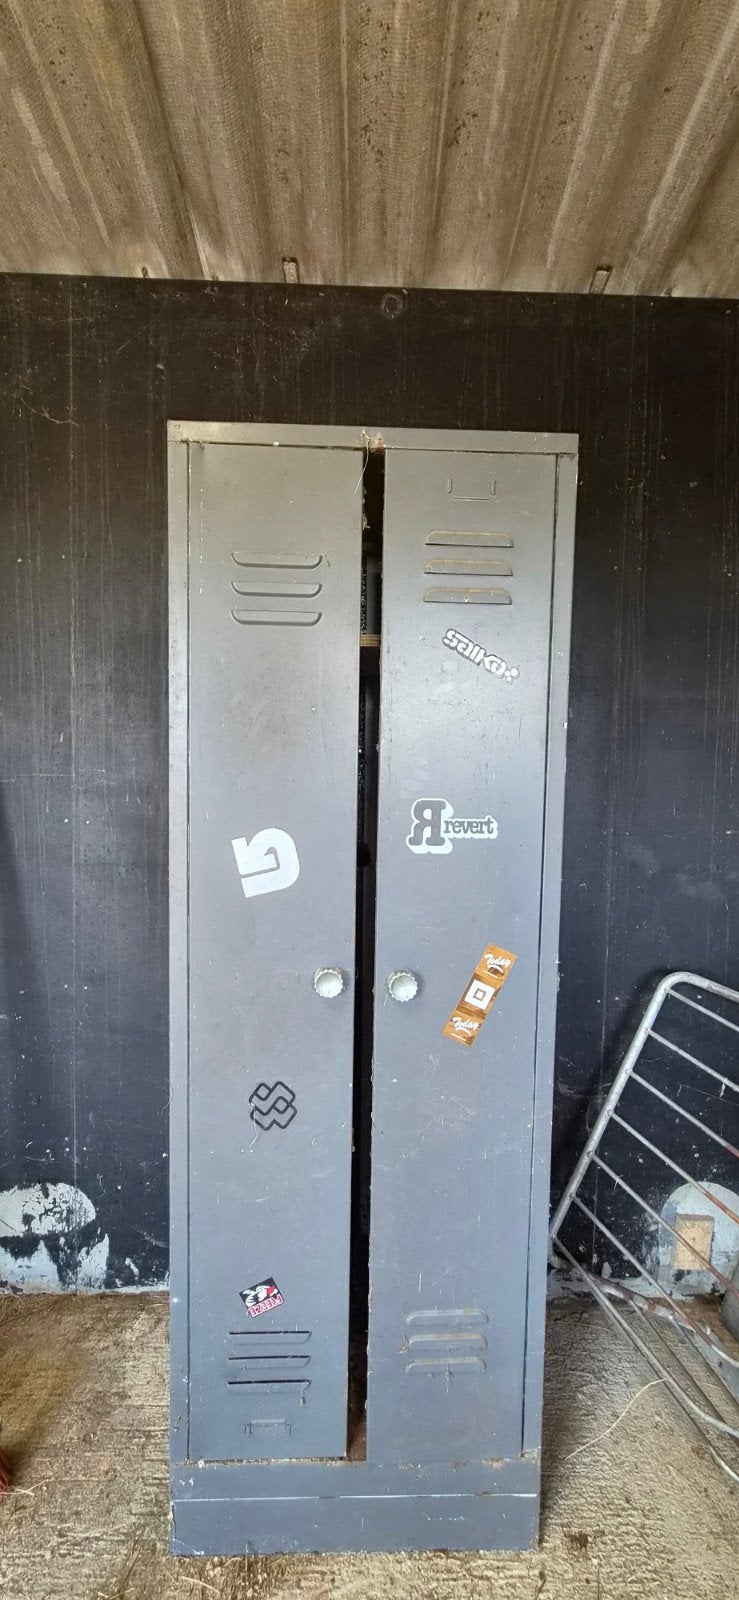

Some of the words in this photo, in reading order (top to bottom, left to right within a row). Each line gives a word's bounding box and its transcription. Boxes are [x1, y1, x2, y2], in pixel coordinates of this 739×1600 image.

[443, 817, 494, 835] revert
[484, 953, 511, 969] Today
[452, 1016, 479, 1032] Today
